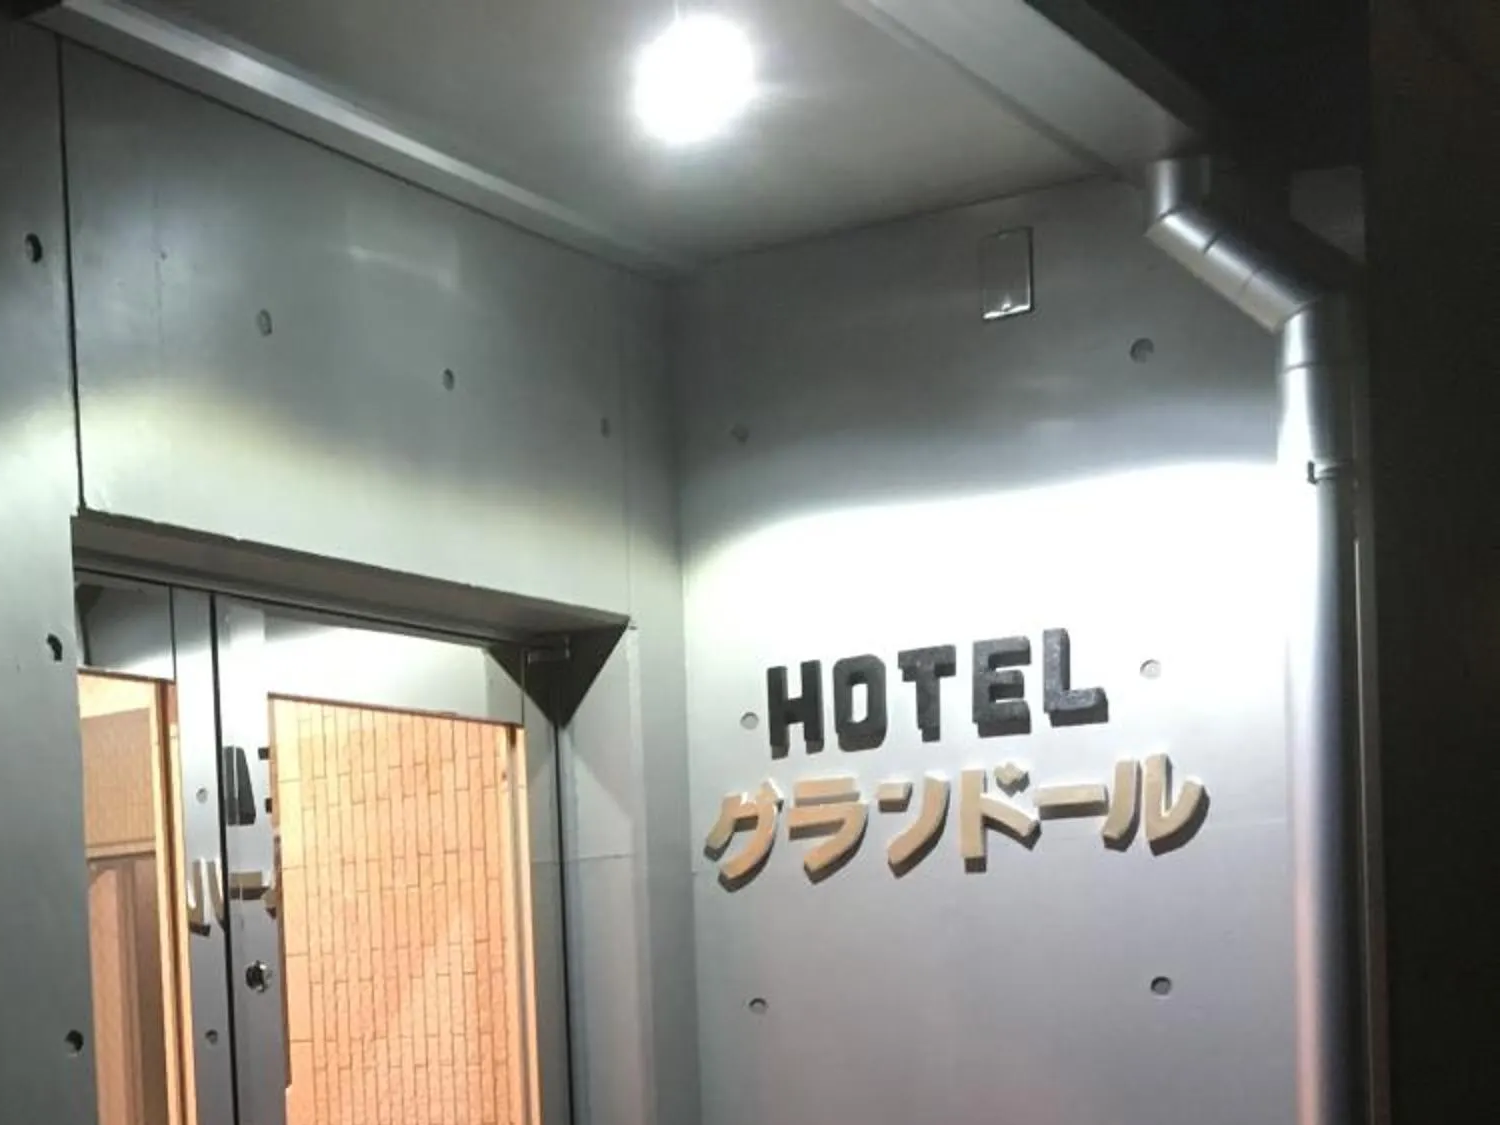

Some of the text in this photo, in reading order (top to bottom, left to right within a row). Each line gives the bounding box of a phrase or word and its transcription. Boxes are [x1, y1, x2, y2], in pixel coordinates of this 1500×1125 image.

[767, 628, 1109, 759] HOTEL
[704, 753, 1210, 892] グランドール
